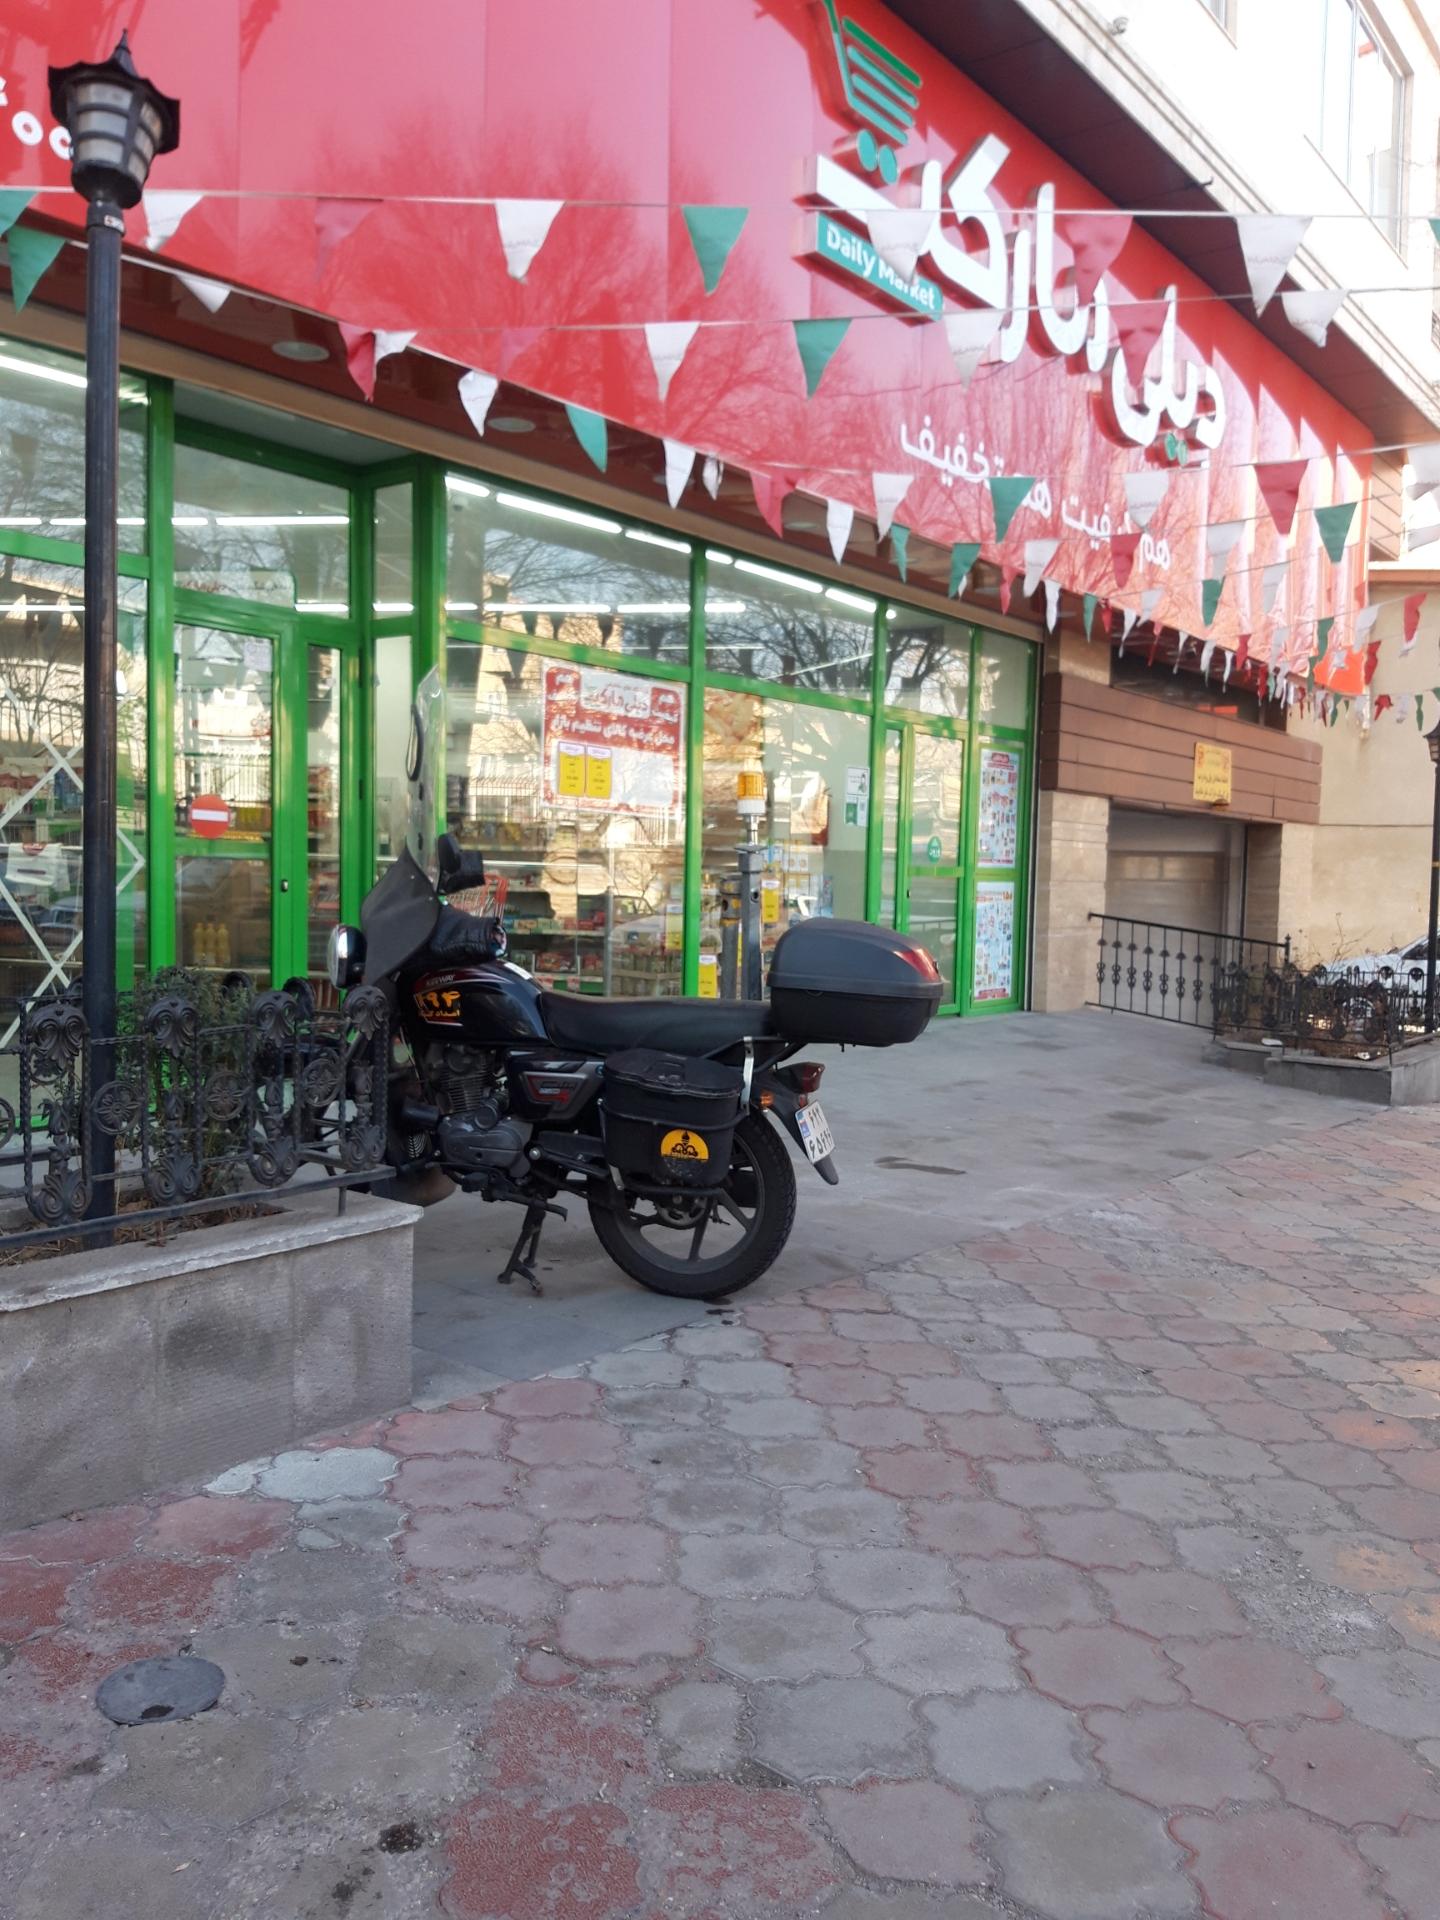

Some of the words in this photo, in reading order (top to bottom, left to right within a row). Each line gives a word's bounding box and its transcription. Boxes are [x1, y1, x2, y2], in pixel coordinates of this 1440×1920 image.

[817, 132, 1109, 373] مارکت
[826, 223, 876, 279] Daily
[1111, 284, 1225, 464] دیلی
[1138, 532, 1170, 574] هم
[571, 719, 601, 733] تنظیم
